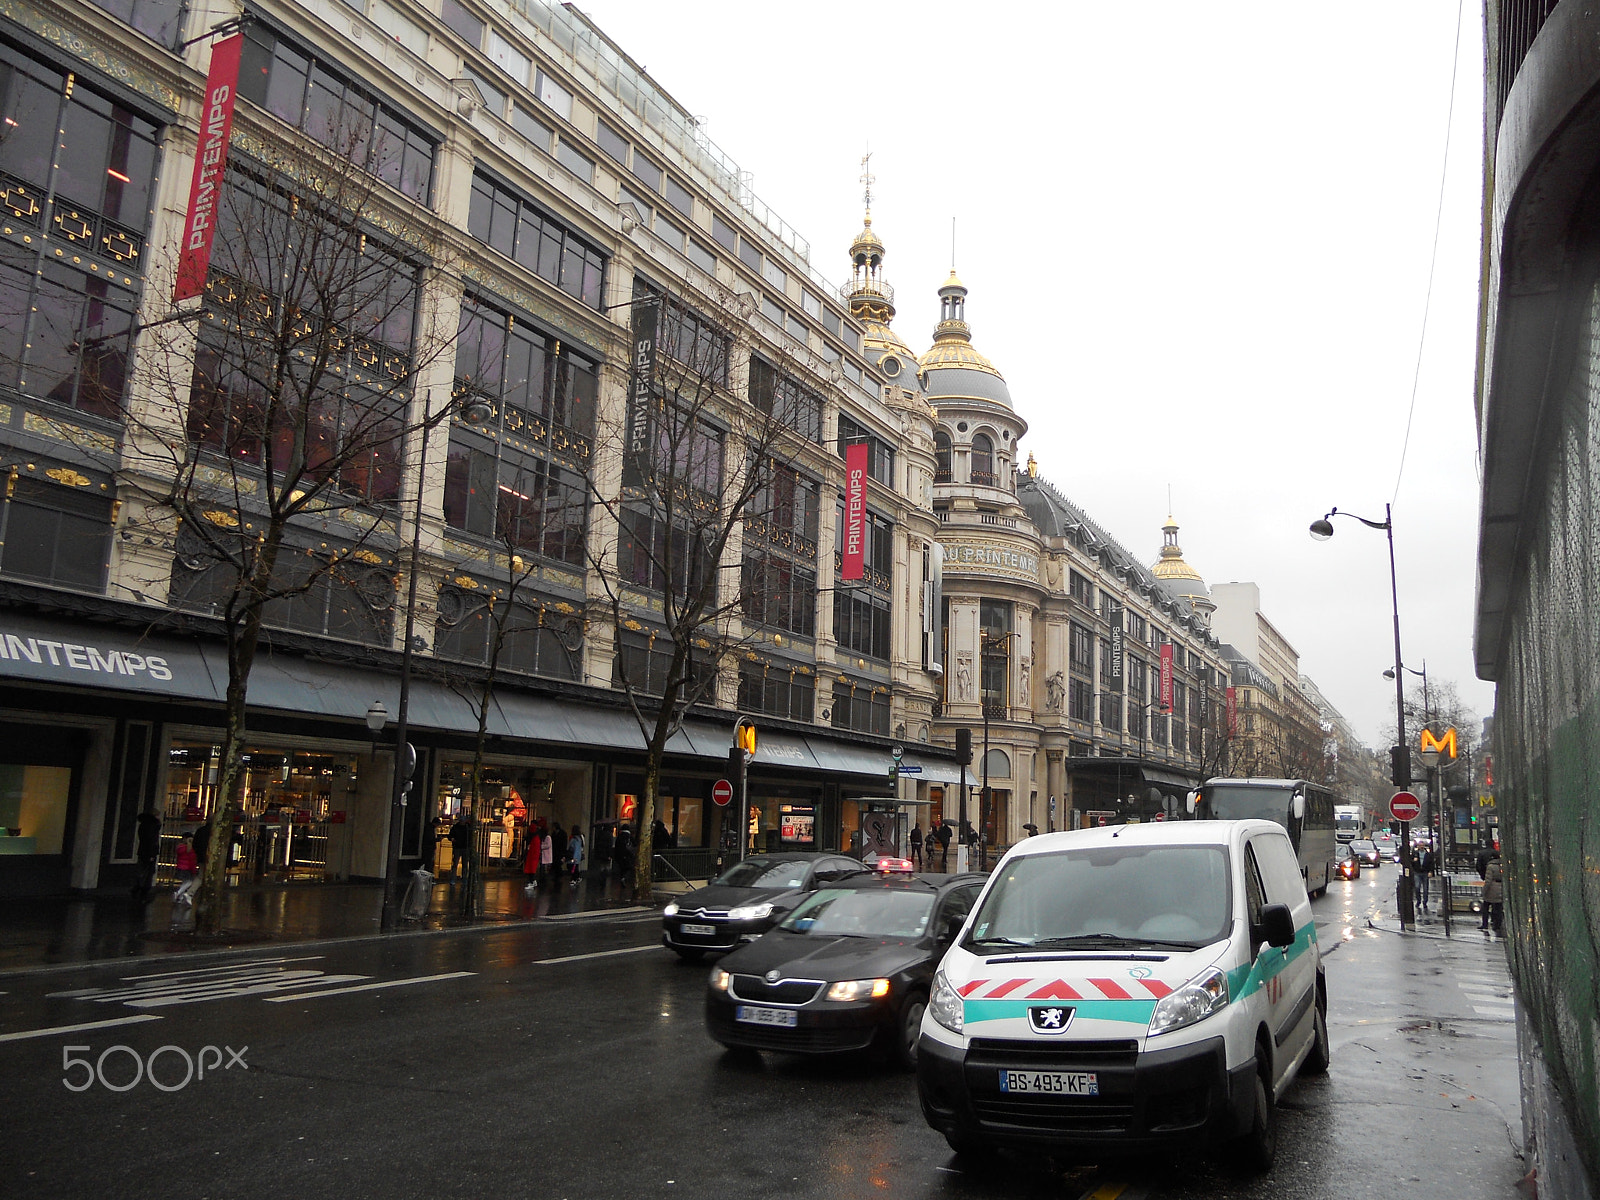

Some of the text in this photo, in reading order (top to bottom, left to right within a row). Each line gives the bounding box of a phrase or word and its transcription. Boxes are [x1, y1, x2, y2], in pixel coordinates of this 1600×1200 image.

[189, 85, 230, 250] PRINTEMPS
[632, 339, 651, 452] PRINTEMPS
[848, 469, 863, 555] PRINTEMPS
[942, 548, 959, 561] AU
[1112, 626, 1121, 677] PRINTEMPS
[1421, 728, 1457, 758] M
[1480, 795, 1495, 807] M
[1008, 1073, 1087, 1093] BS-493-KF
[1089, 1084, 1098, 1093] 75
